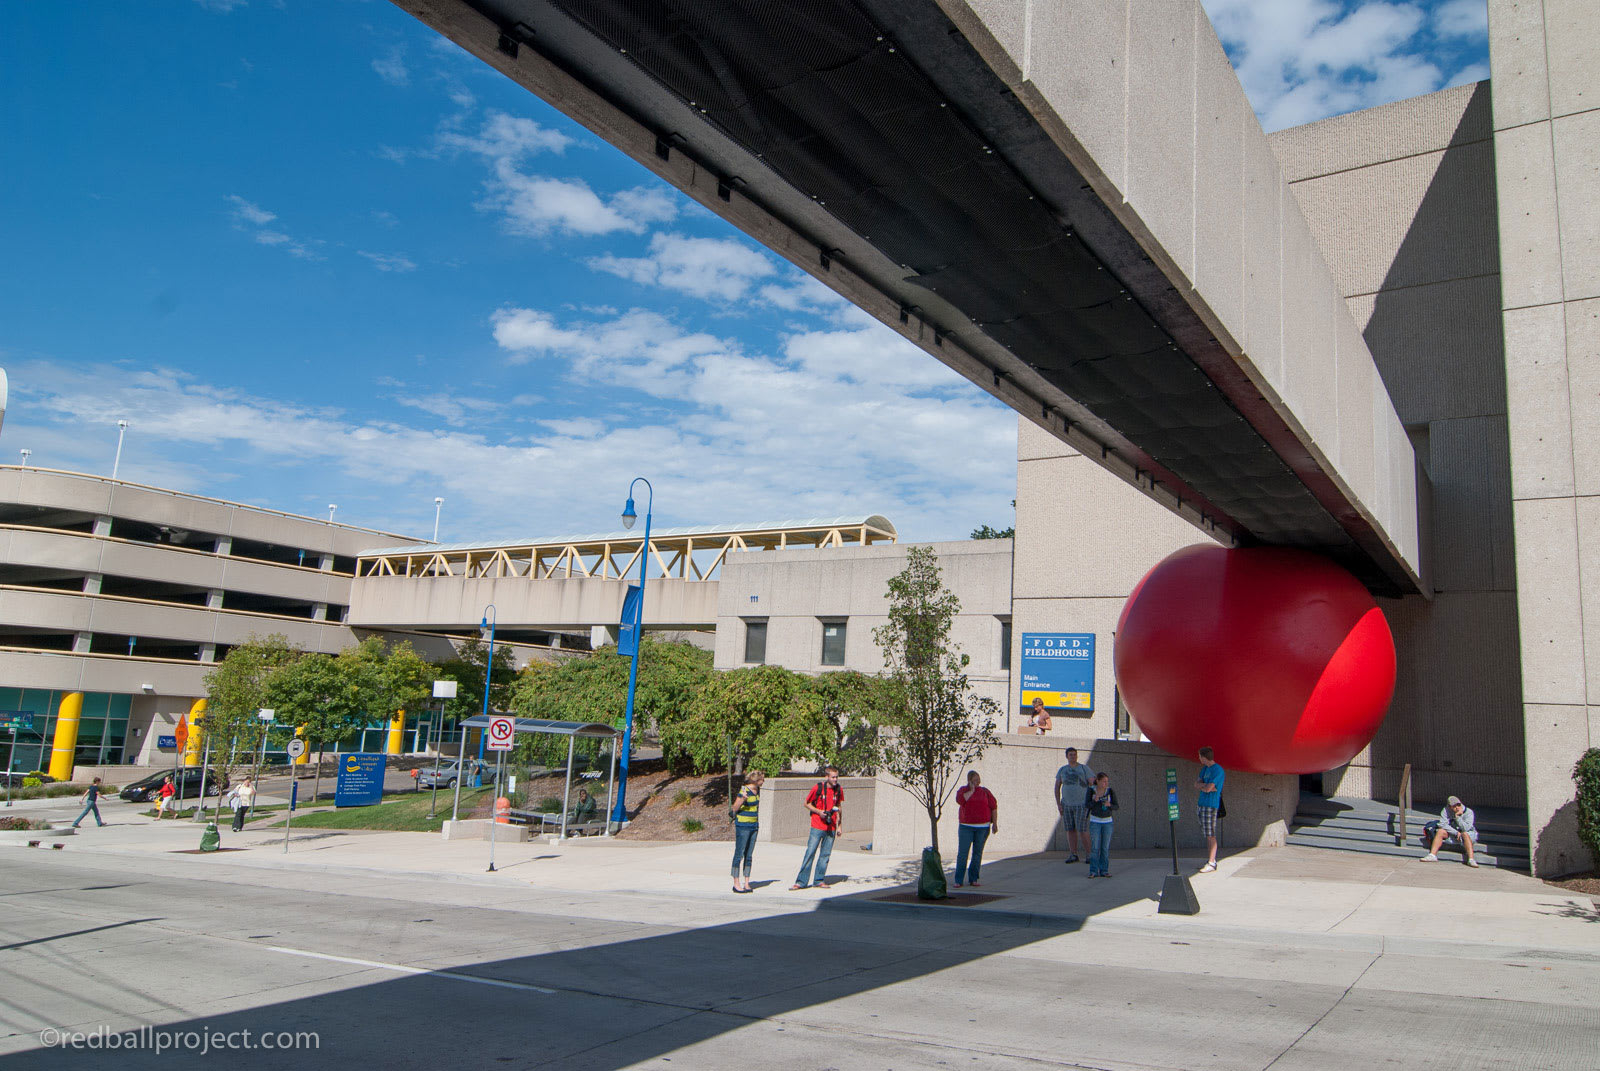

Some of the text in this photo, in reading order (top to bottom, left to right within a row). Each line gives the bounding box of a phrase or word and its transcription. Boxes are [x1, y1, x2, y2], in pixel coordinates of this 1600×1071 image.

[750, 595, 759, 603] 111
[1034, 639, 1081, 648] FORD
[1024, 648, 1089, 657] FIELDHOUSE
[1023, 681, 1051, 689] Entrance
